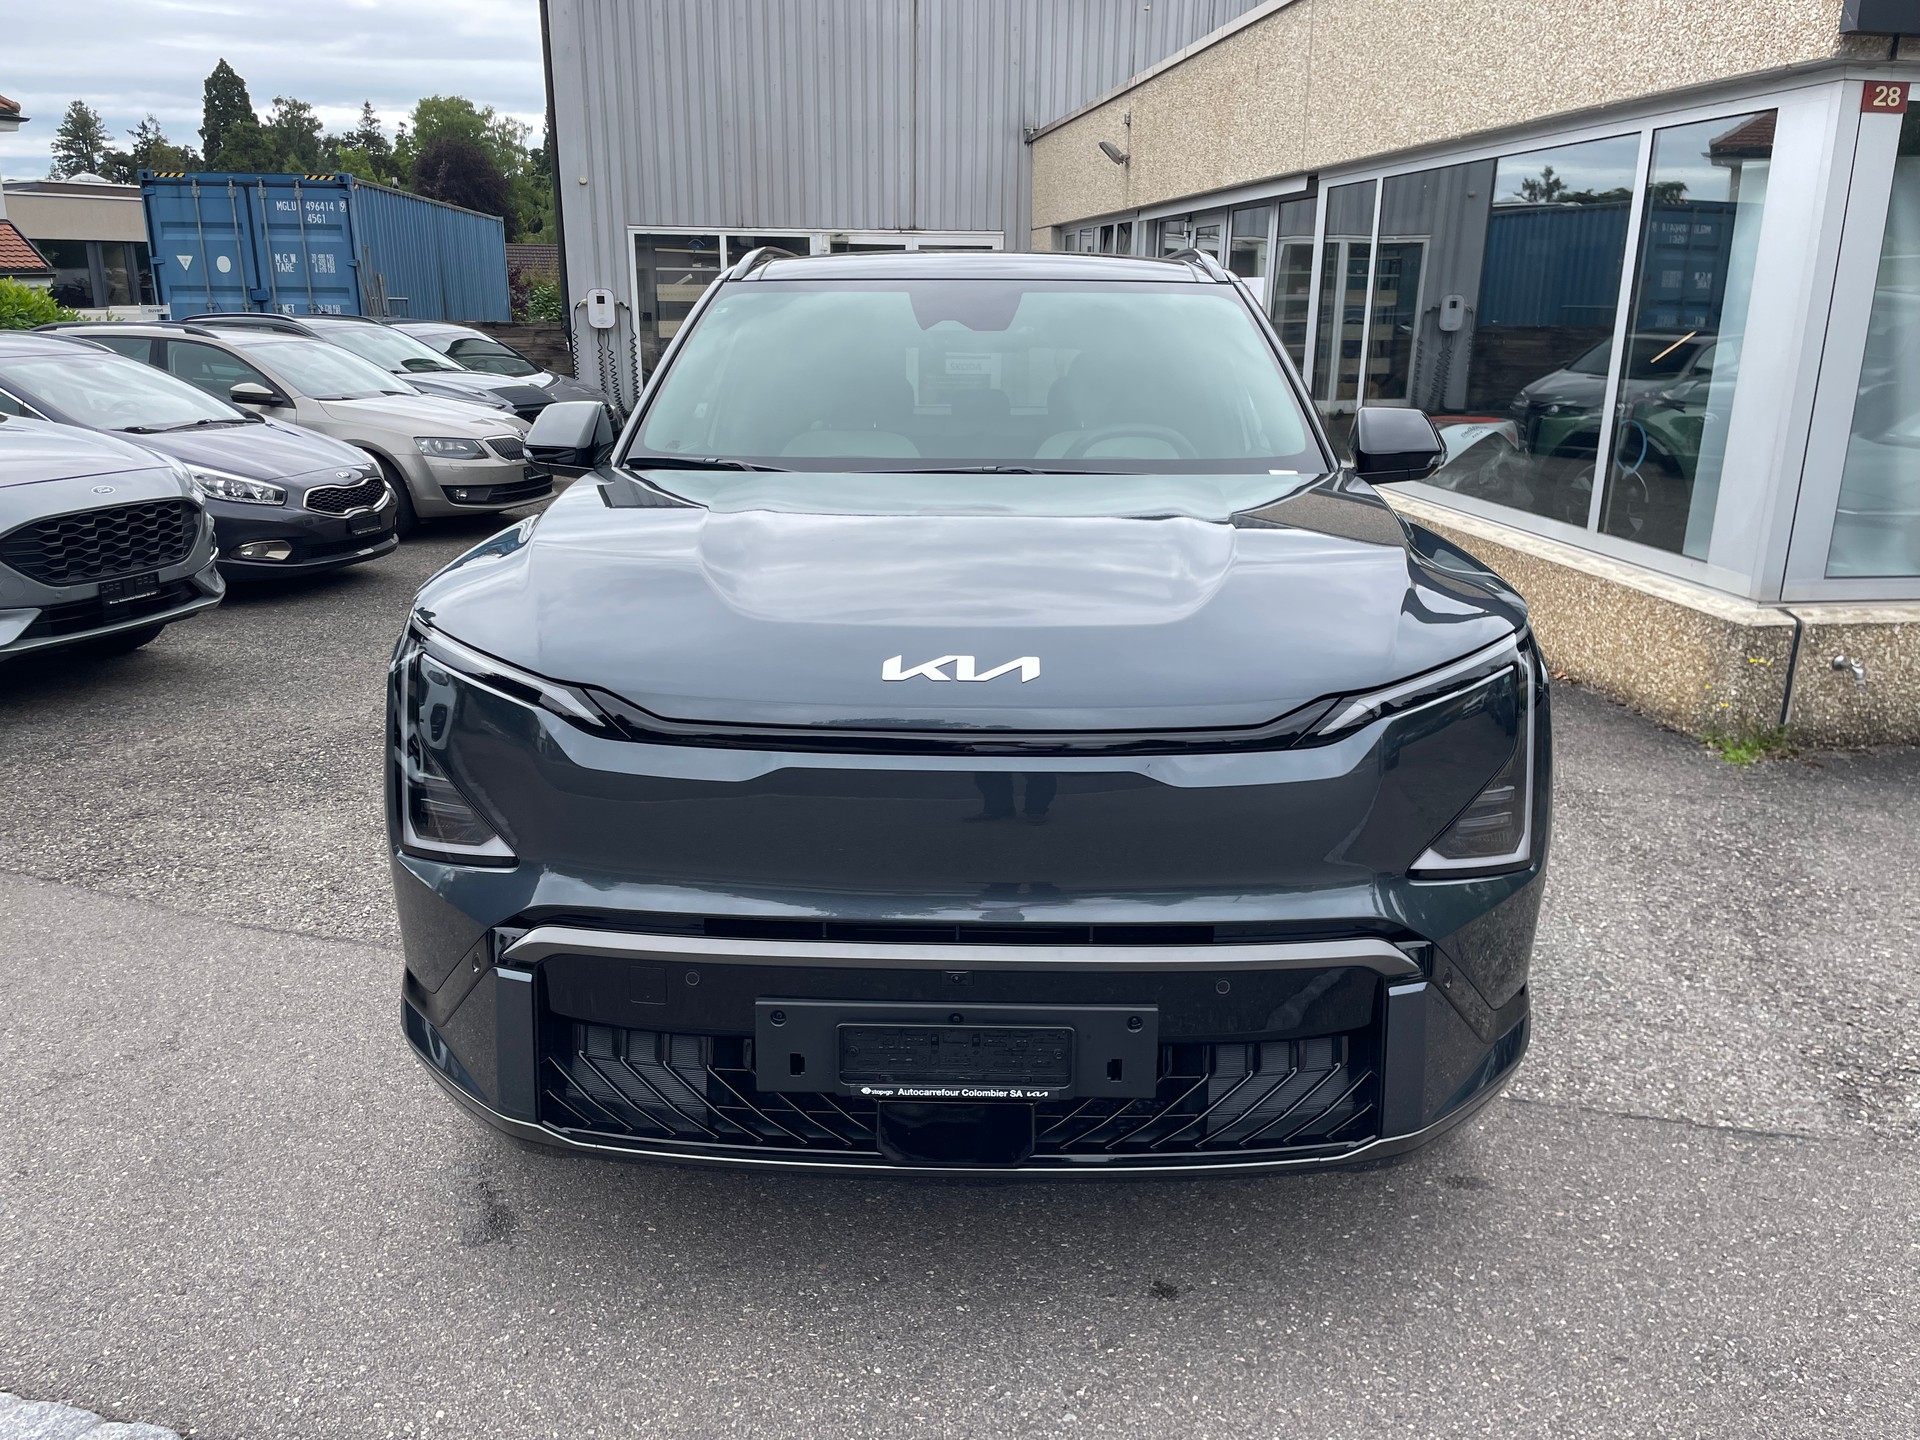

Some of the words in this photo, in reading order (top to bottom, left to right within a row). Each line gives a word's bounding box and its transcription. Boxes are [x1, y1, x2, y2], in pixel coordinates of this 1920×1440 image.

[1873, 86, 1901, 107] 28
[276, 201, 297, 211] MGLU
[305, 201, 334, 212] 496414
[340, 201, 347, 212] 9
[307, 214, 326, 224] 45G1
[276, 263, 295, 273] TARE
[282, 304, 295, 314] NET
[882, 654, 1041, 684] KIA
[898, 1087, 960, 1097] Autocarrefour
[961, 1088, 1008, 1097] Colombier
[1009, 1089, 1023, 1098] SA
